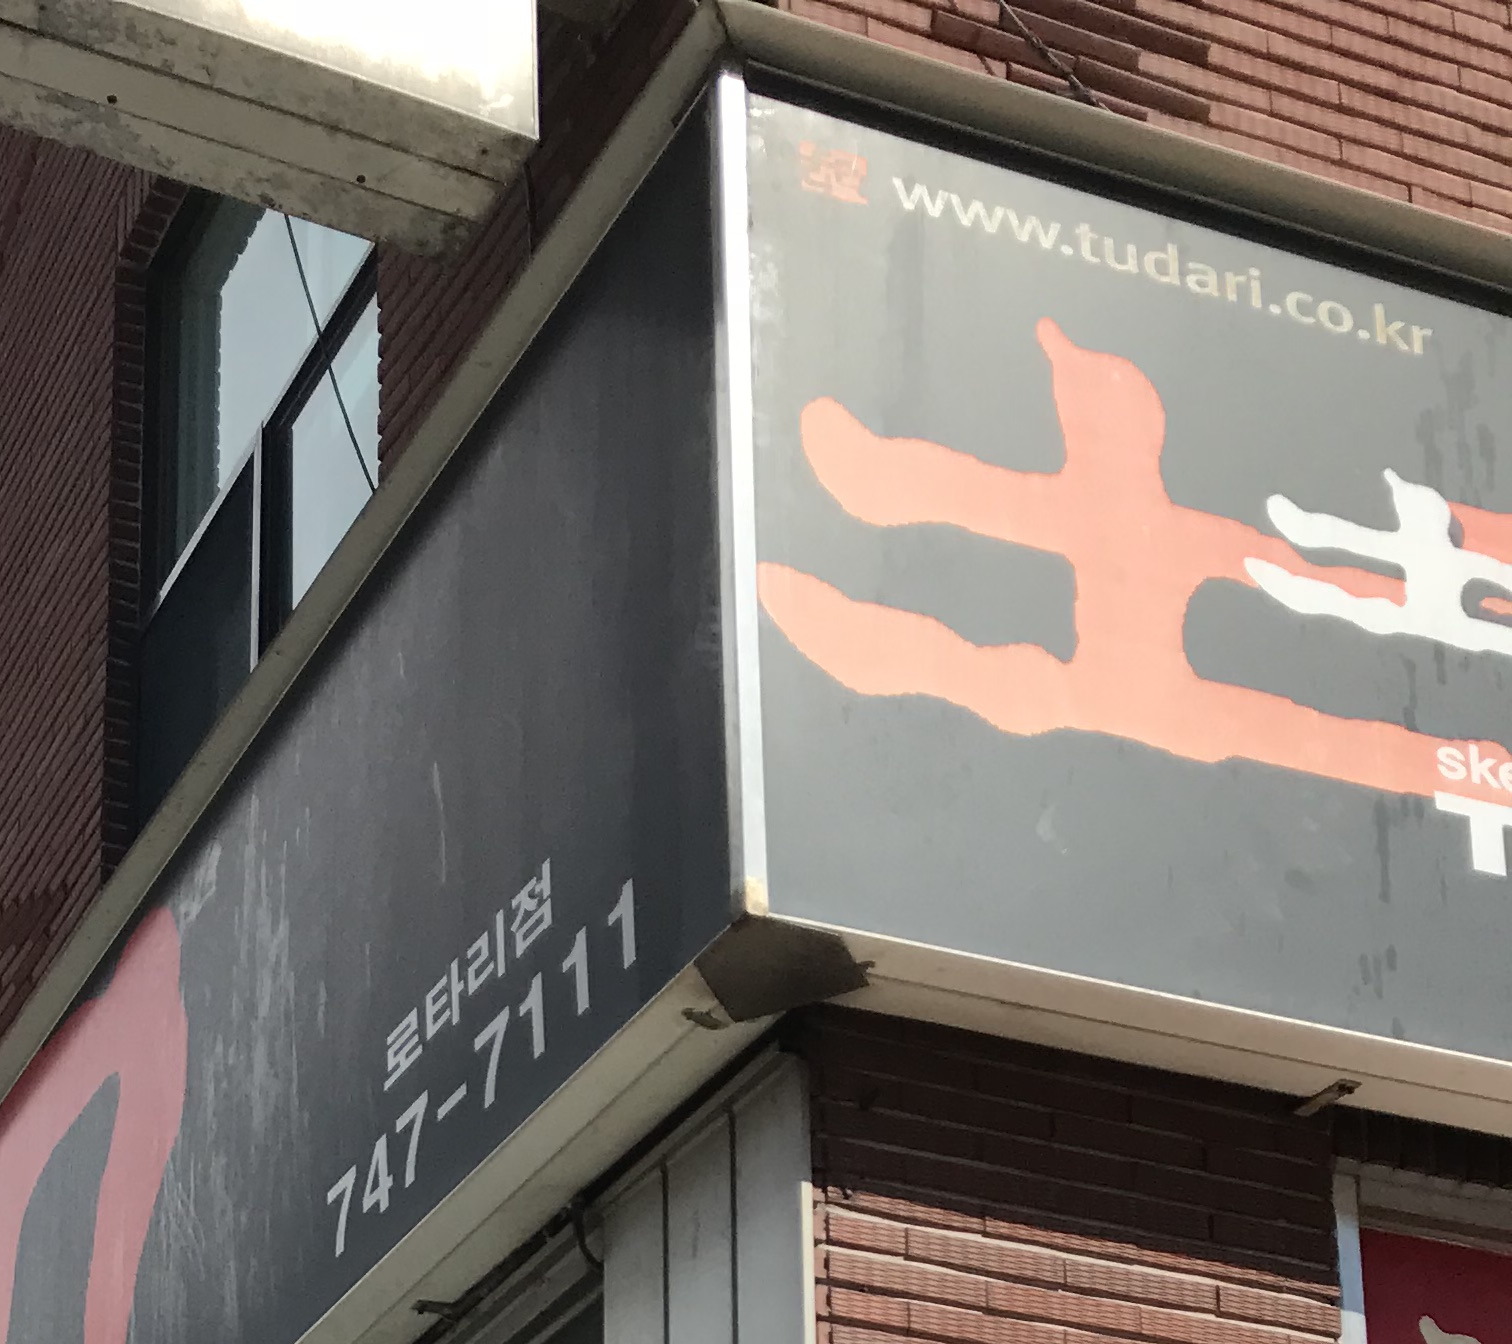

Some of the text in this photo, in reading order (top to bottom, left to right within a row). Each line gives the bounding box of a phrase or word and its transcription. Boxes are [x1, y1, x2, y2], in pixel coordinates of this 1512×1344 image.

[891, 175, 1434, 357] www.tudari.co.kr
[326, 877, 638, 1258] 747-7111
[383, 857, 554, 1092] 로타리점
